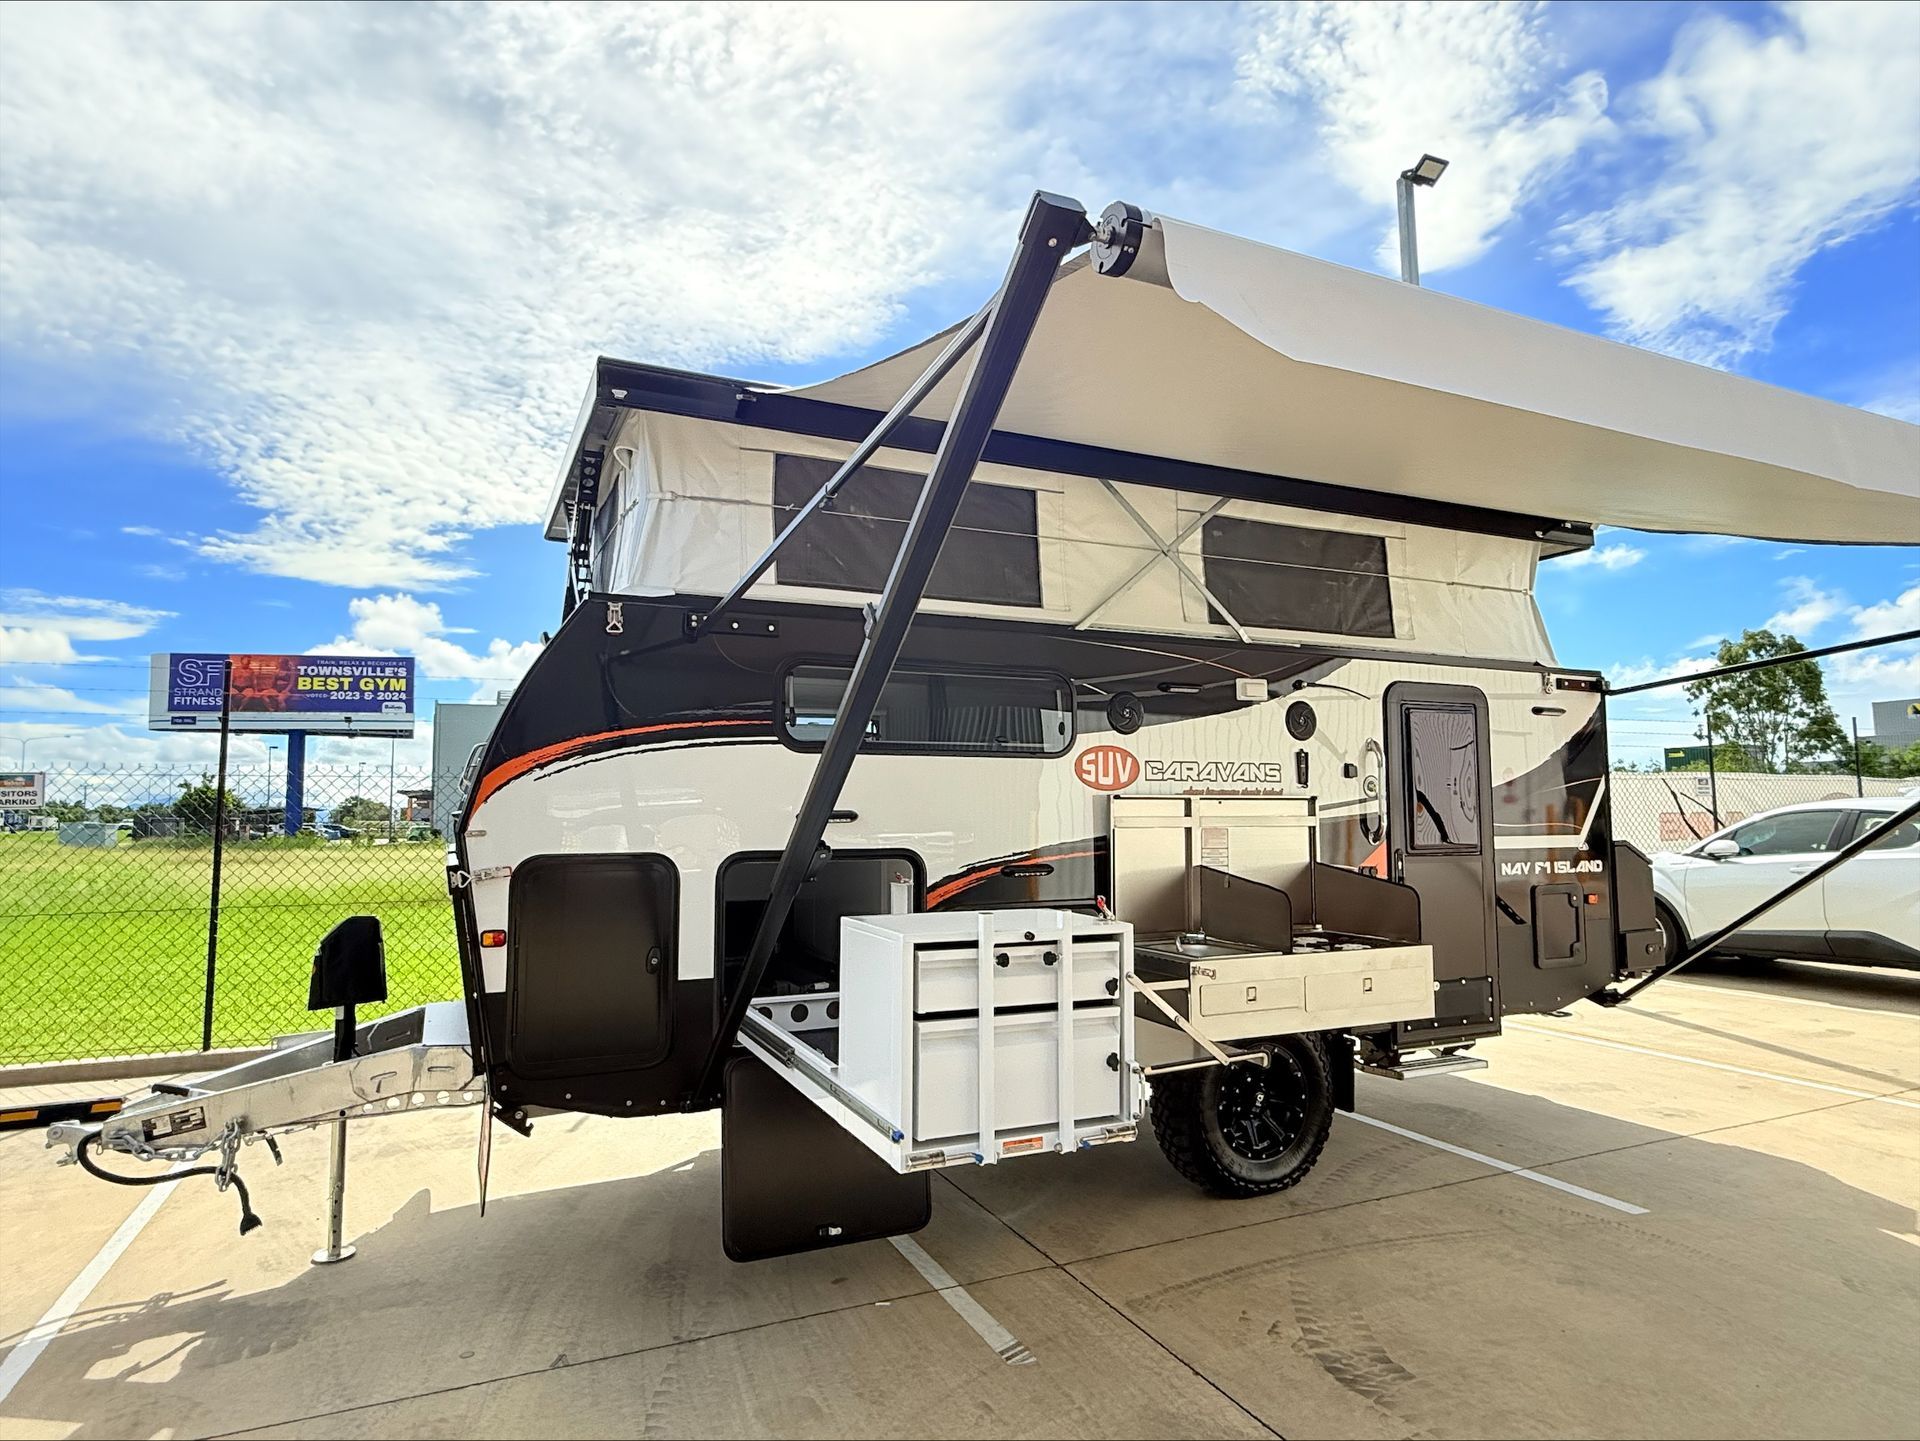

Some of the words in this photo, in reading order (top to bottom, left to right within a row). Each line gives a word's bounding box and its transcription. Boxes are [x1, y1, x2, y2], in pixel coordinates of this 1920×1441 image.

[177, 658, 223, 687] SF
[297, 665, 407, 677] TOWNSVILLE'S
[297, 676, 353, 690] BEST
[359, 677, 406, 691] GYM
[174, 687, 223, 696] STRAND
[330, 691, 360, 700] 2023
[363, 692, 374, 700] &
[376, 692, 406, 700] 2024
[174, 697, 223, 706] FITNESS
[1082, 751, 1132, 785] SUV
[1144, 760, 1282, 783] CARAVANS
[0, 798, 37, 806] ARKING
[1501, 861, 1531, 876] NAV
[1553, 859, 1603, 874] ISLAND
